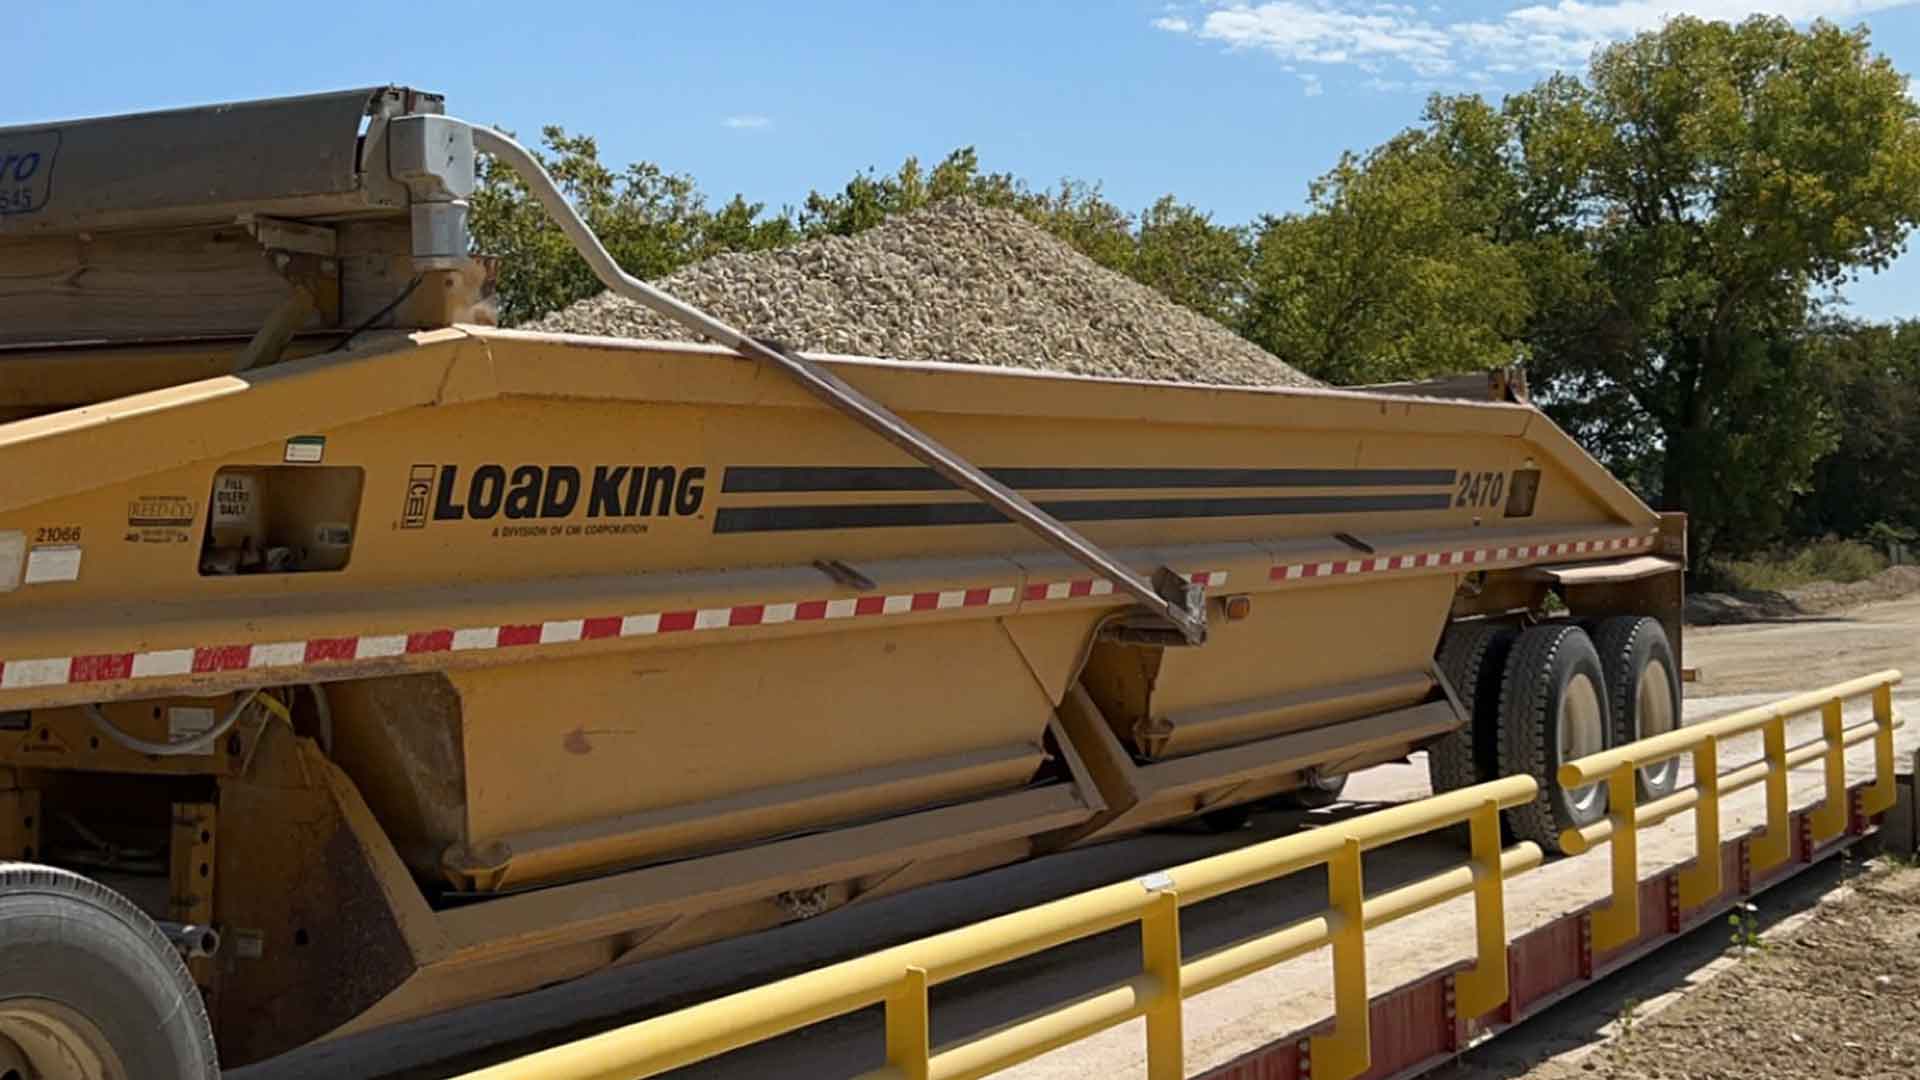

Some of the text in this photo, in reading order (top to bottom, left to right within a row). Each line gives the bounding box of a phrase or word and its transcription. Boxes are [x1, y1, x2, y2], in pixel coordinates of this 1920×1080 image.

[1455, 471, 1504, 508] 2470
[35, 526, 81, 542] 21066
[502, 525, 547, 537] DIVISION
[584, 523, 649, 535] CORPORATION
